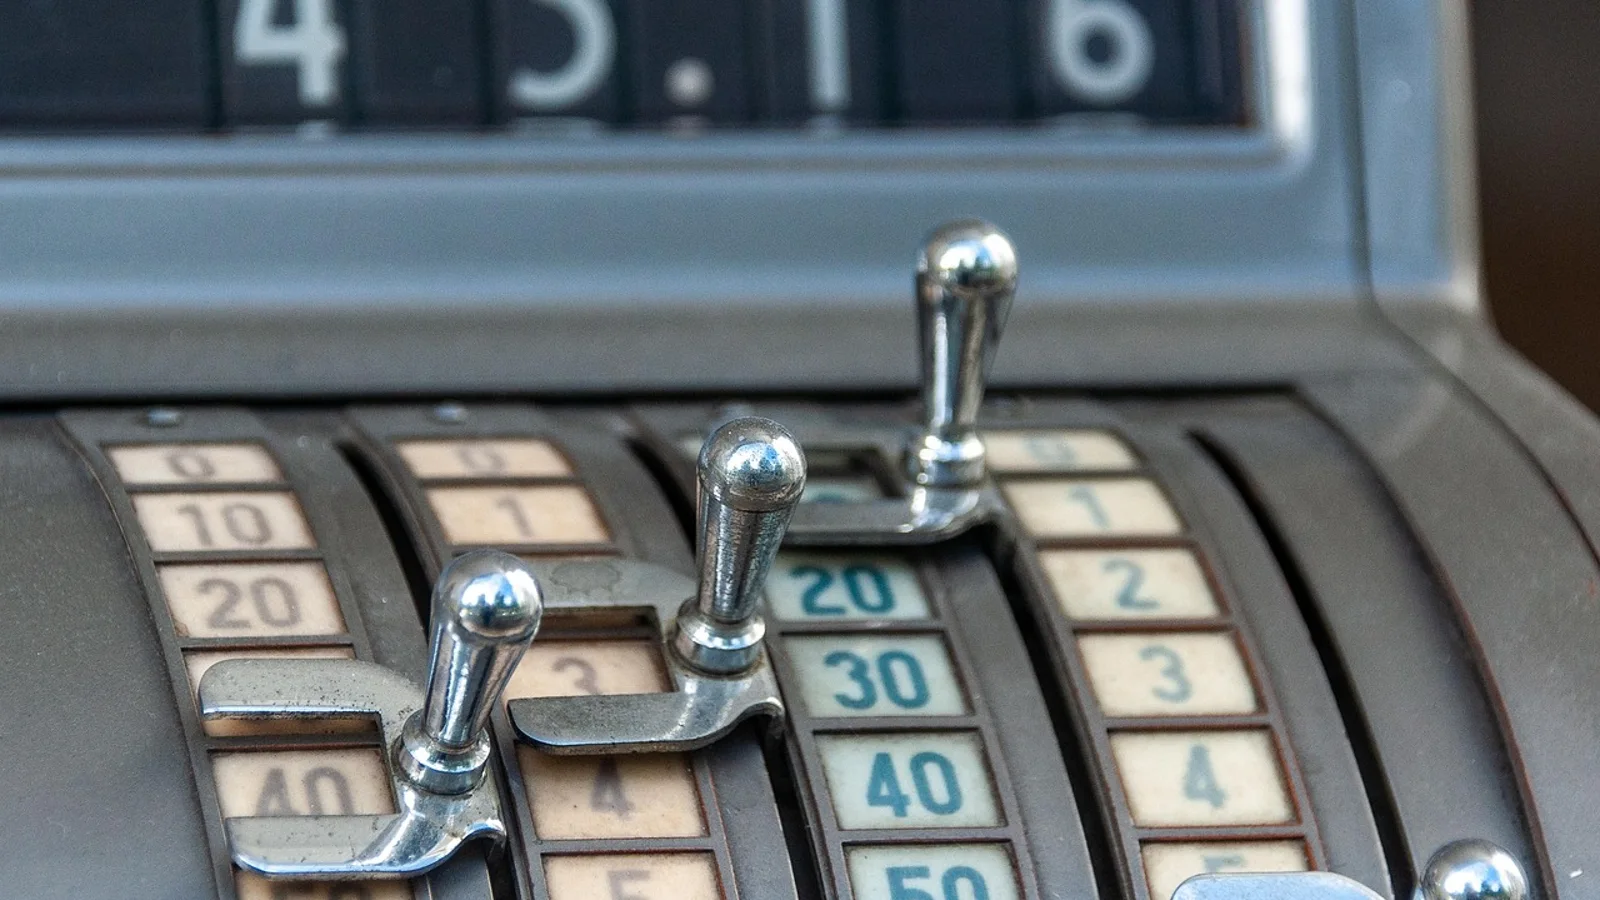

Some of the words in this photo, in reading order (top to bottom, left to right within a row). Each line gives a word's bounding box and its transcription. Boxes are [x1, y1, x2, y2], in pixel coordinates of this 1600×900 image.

[167, 450, 216, 479] 0
[176, 503, 273, 546] 10
[497, 498, 534, 538] 1
[1067, 485, 1112, 530] 1
[197, 577, 301, 629] 20
[789, 565, 895, 615] 20
[1103, 558, 1160, 610] 2
[823, 650, 931, 710] 30
[1138, 645, 1192, 703] 3
[867, 751, 962, 818] 40
[1184, 743, 1228, 808] 4
